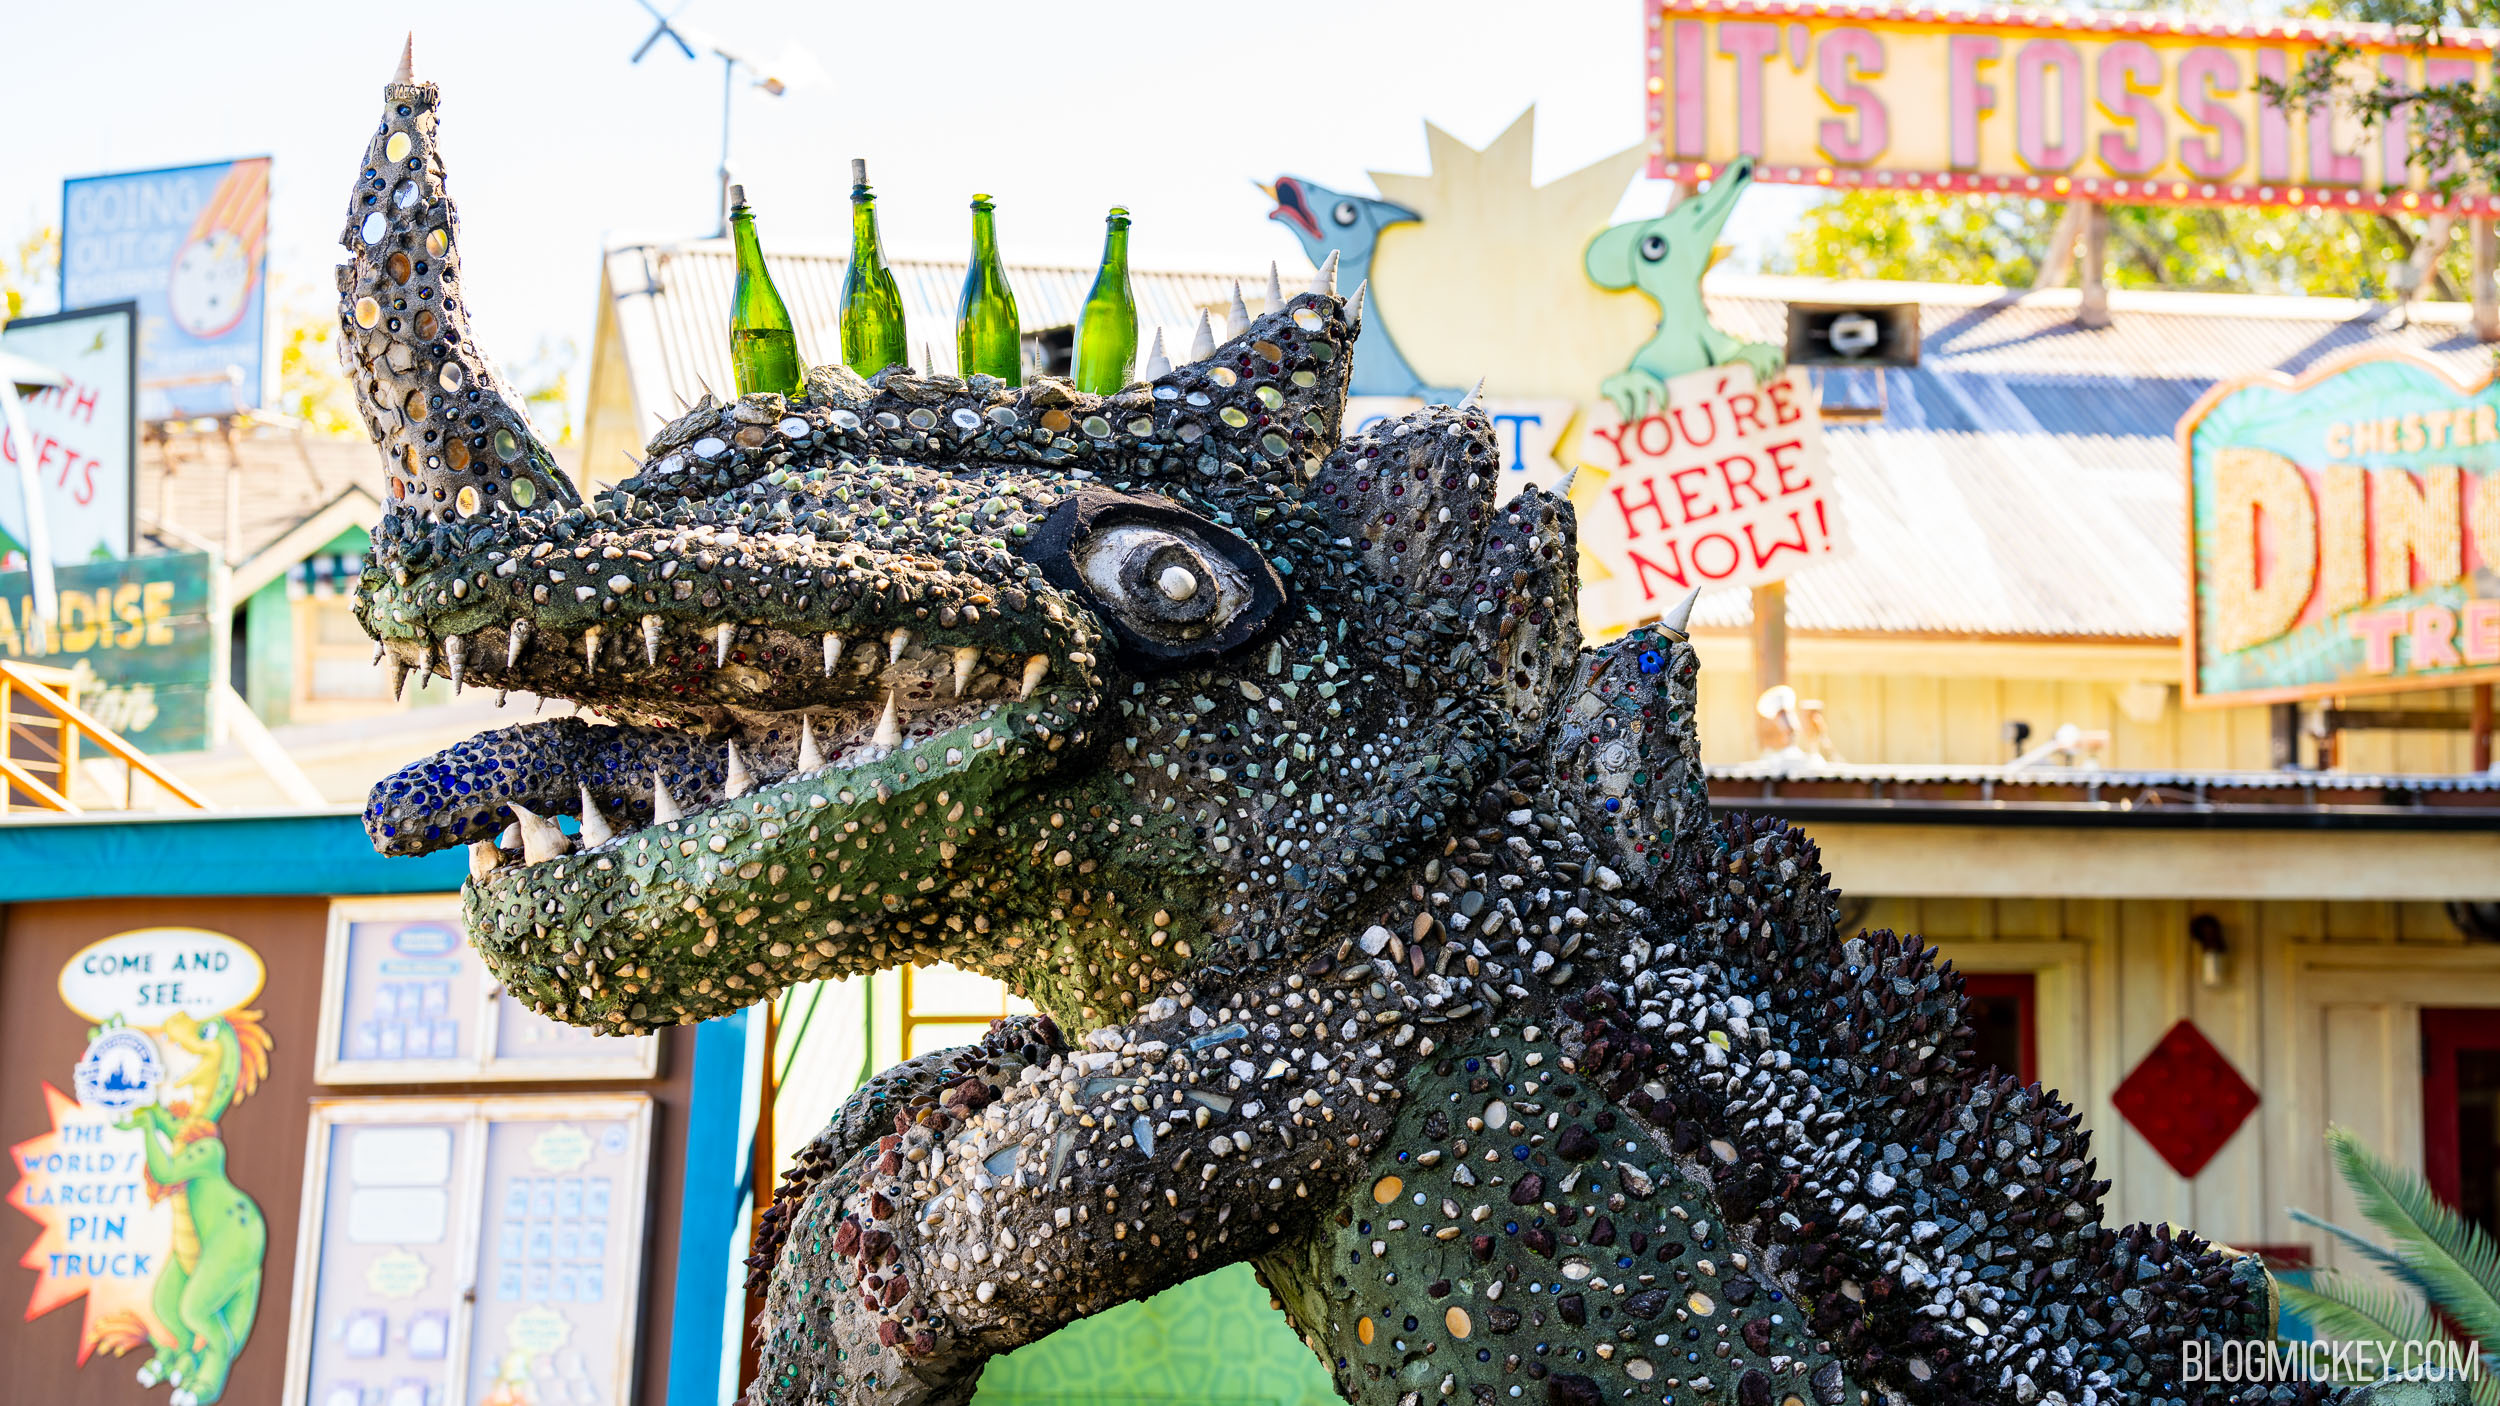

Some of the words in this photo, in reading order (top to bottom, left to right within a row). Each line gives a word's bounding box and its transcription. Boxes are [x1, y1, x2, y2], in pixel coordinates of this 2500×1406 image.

[1672, 20, 1889, 164] IT'S
[70, 177, 201, 234] GOING
[72, 231, 142, 274] OUT
[1593, 377, 1802, 468] YOU'RE
[1612, 440, 1812, 540] HERE
[1627, 498, 1832, 601] NOW!
[83, 953, 153, 976] COME
[171, 951, 230, 972] AND
[138, 982, 213, 1007] SEE...
[62, 1124, 104, 1144] THE
[24, 1152, 139, 1173] WORLD'S
[25, 1184, 139, 1205] LARGEST
[68, 1215, 127, 1242] PIN
[49, 1252, 152, 1278] TRUCK
